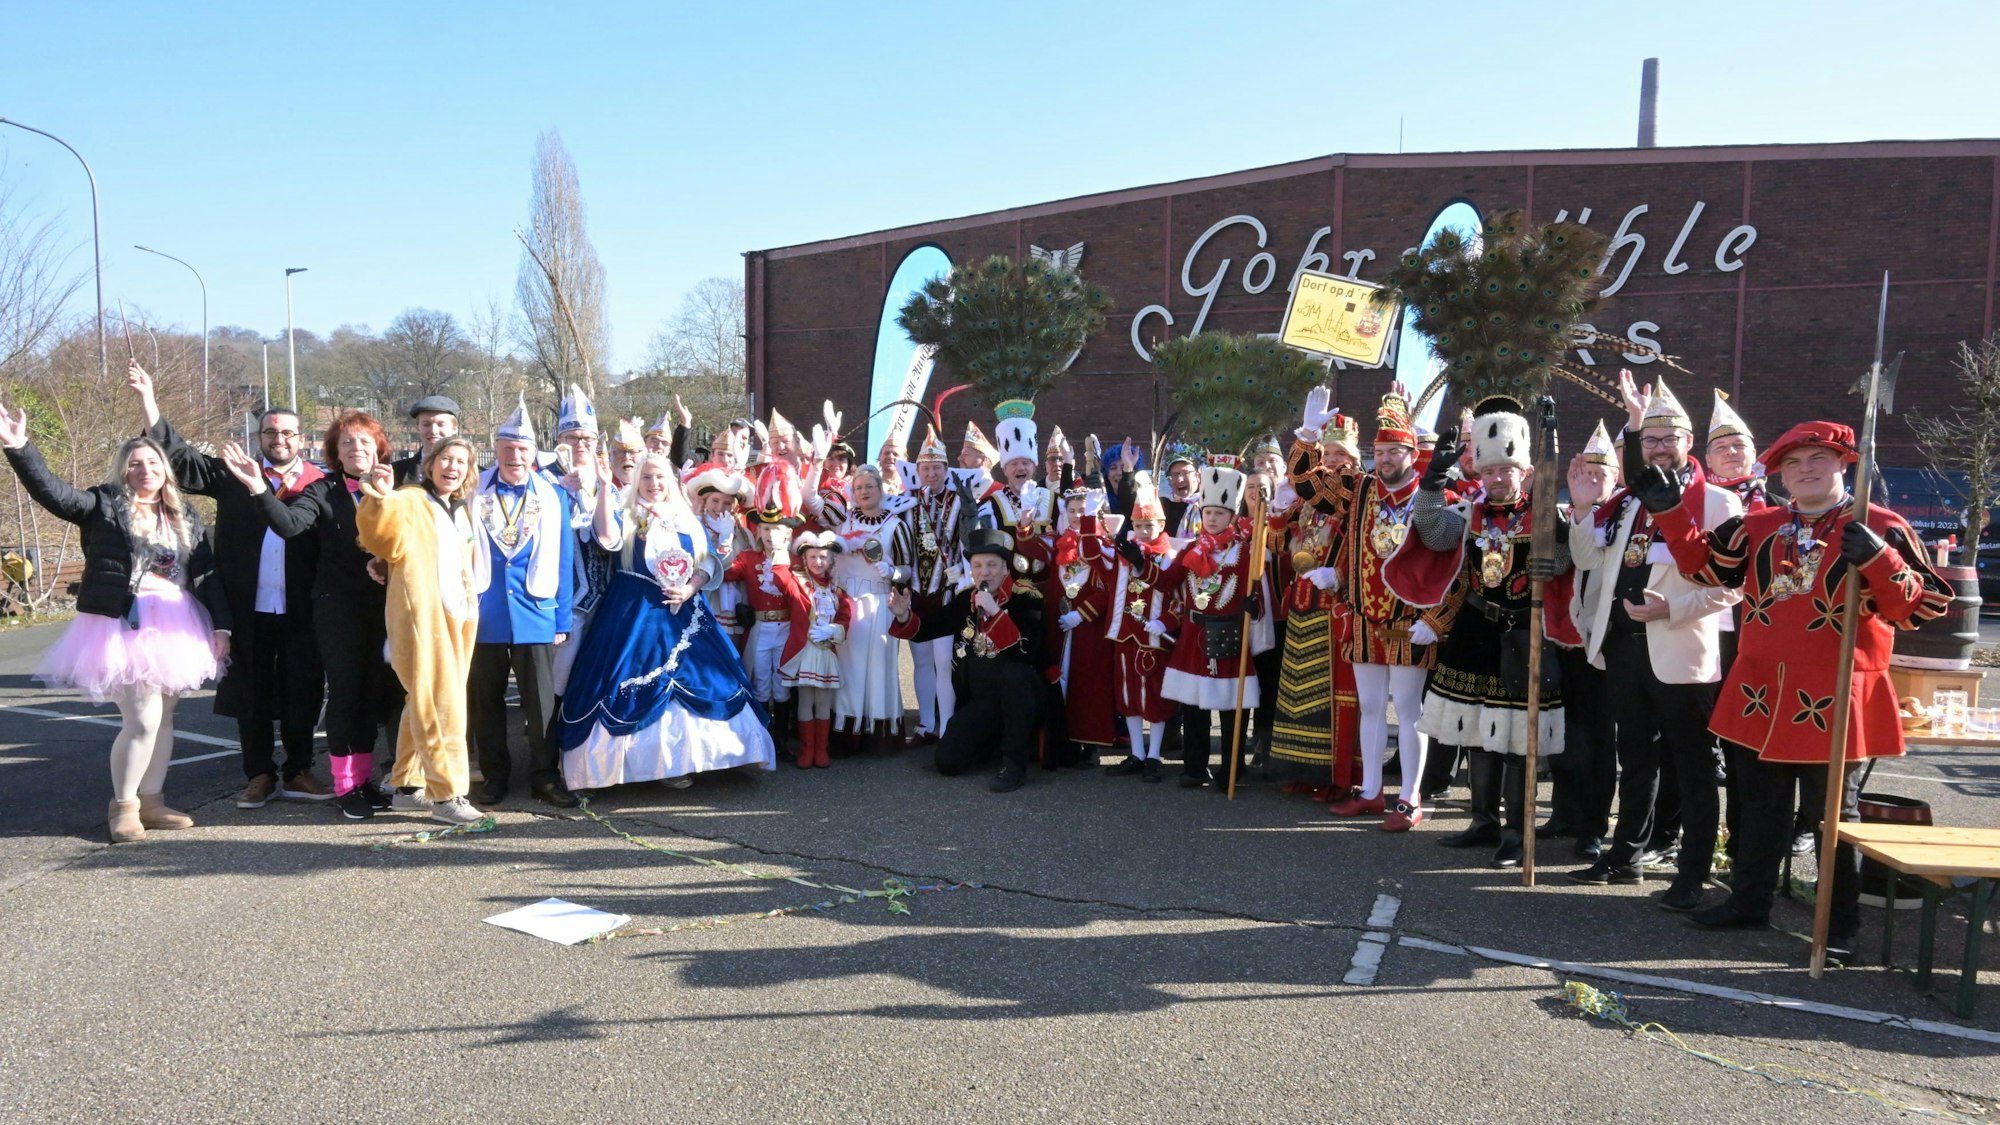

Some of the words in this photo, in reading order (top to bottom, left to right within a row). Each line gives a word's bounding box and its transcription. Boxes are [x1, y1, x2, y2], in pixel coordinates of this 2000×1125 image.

[1302, 278, 1329, 292] Dorf
[1330, 286, 1344, 297] op
[1937, 521, 1959, 530] 2023
